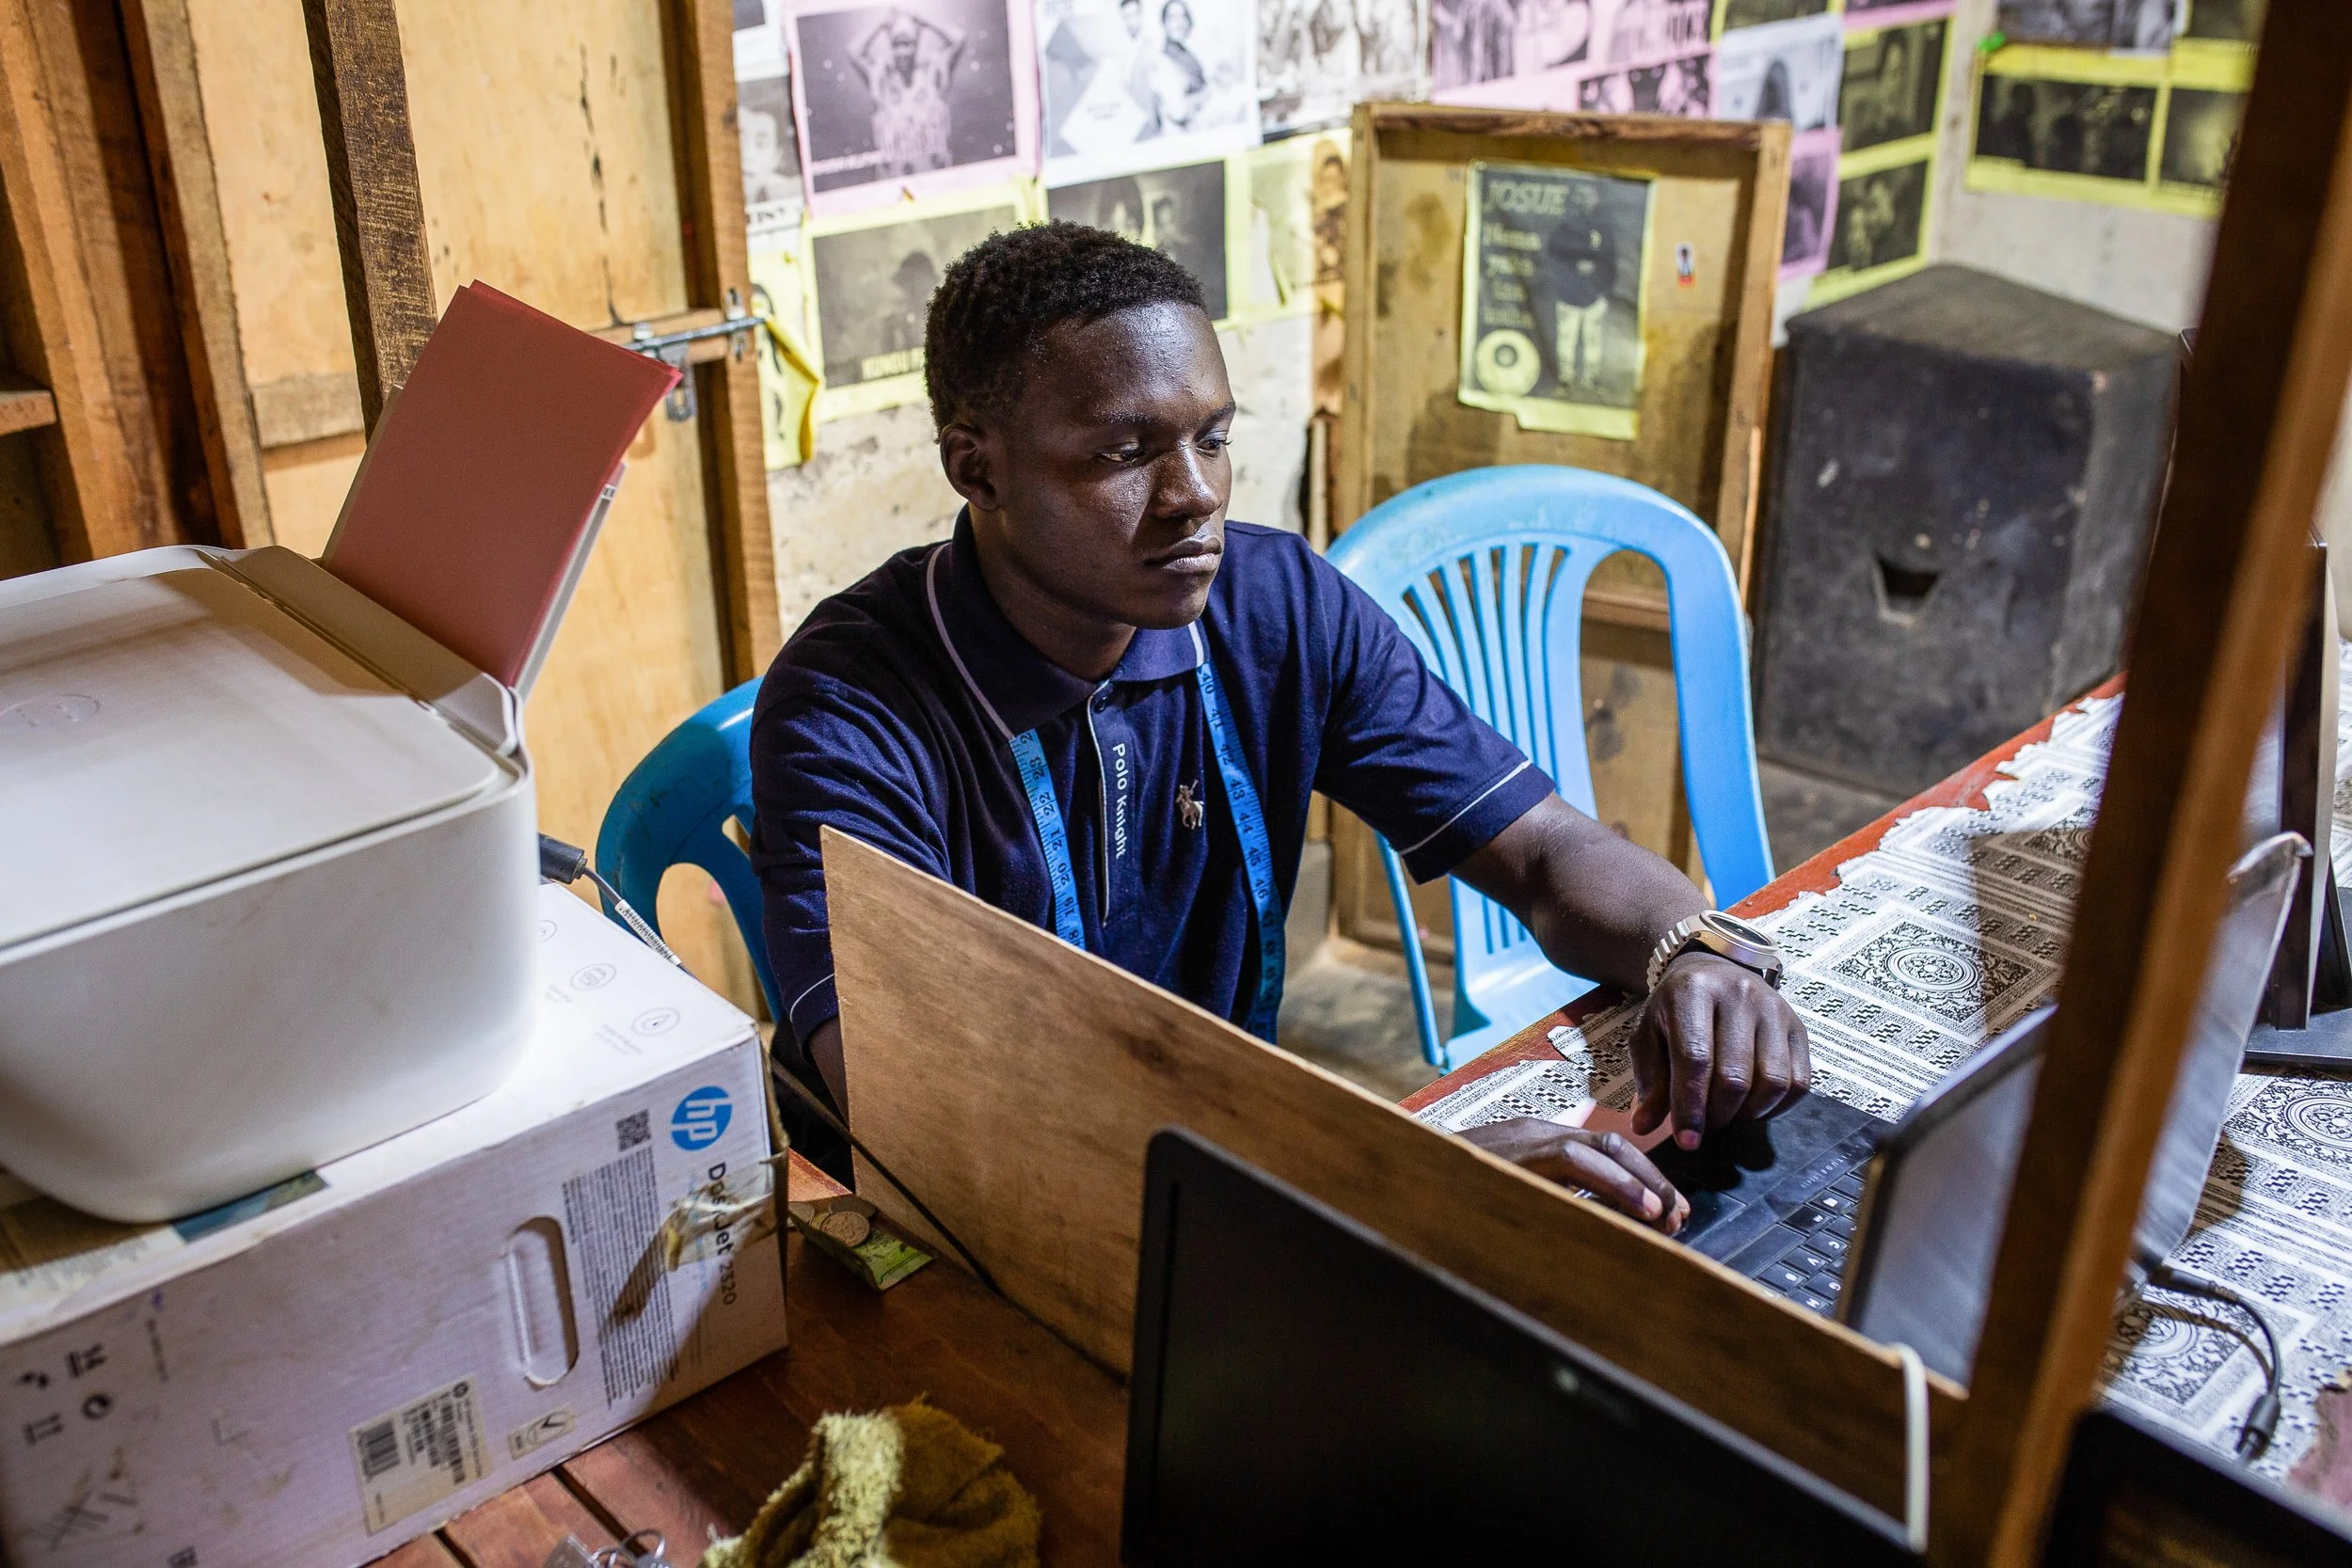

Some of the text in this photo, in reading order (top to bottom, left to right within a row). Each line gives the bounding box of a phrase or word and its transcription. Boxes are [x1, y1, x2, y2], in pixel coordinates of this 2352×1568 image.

[1202, 673, 1215, 694] 40
[1211, 708, 1224, 731] 41
[1220, 744, 1233, 766] 42
[1029, 756, 1044, 780] 23
[1230, 779, 1246, 800] 43
[1039, 792, 1055, 816] 22
[1112, 742, 1129, 860] Polo Knight
[1239, 812, 1253, 834] 44
[1050, 827, 1062, 851] 21
[1248, 847, 1262, 866] 45
[1057, 863, 1070, 885] 20
[1255, 879, 1269, 899] 46
[1064, 896, 1075, 917] 19
[672, 1095, 732, 1142] hp
[1806, 1257, 1820, 1266] V
